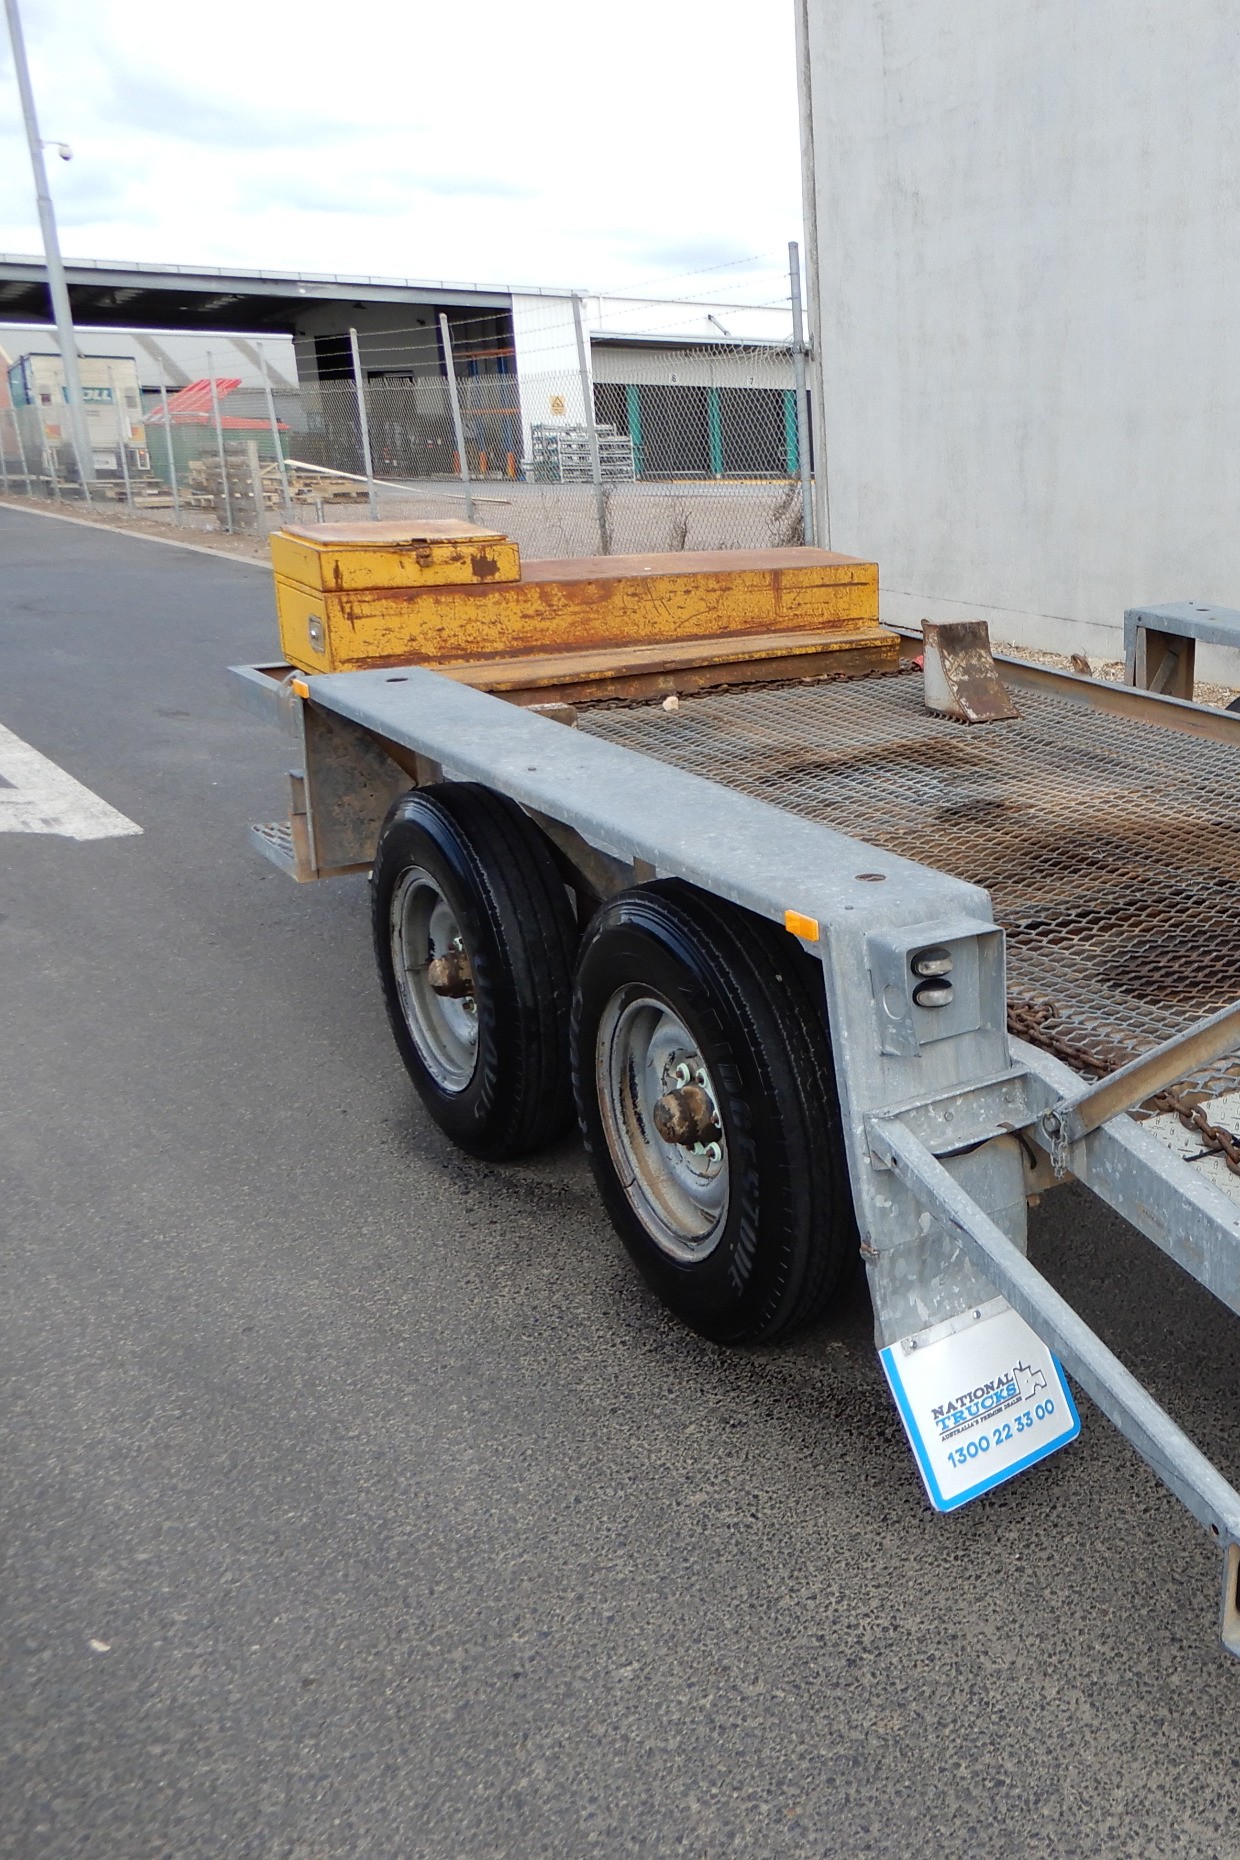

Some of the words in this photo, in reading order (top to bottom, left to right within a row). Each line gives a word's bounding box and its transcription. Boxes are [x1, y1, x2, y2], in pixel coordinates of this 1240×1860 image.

[931, 1373, 1014, 1420] NATIONAL
[935, 1382, 1018, 1431] TRUCKS
[947, 1435, 991, 1468] 1300
[992, 1423, 1014, 1446] 22
[1014, 1410, 1034, 1433] 33
[1035, 1399, 1054, 1420] 00
